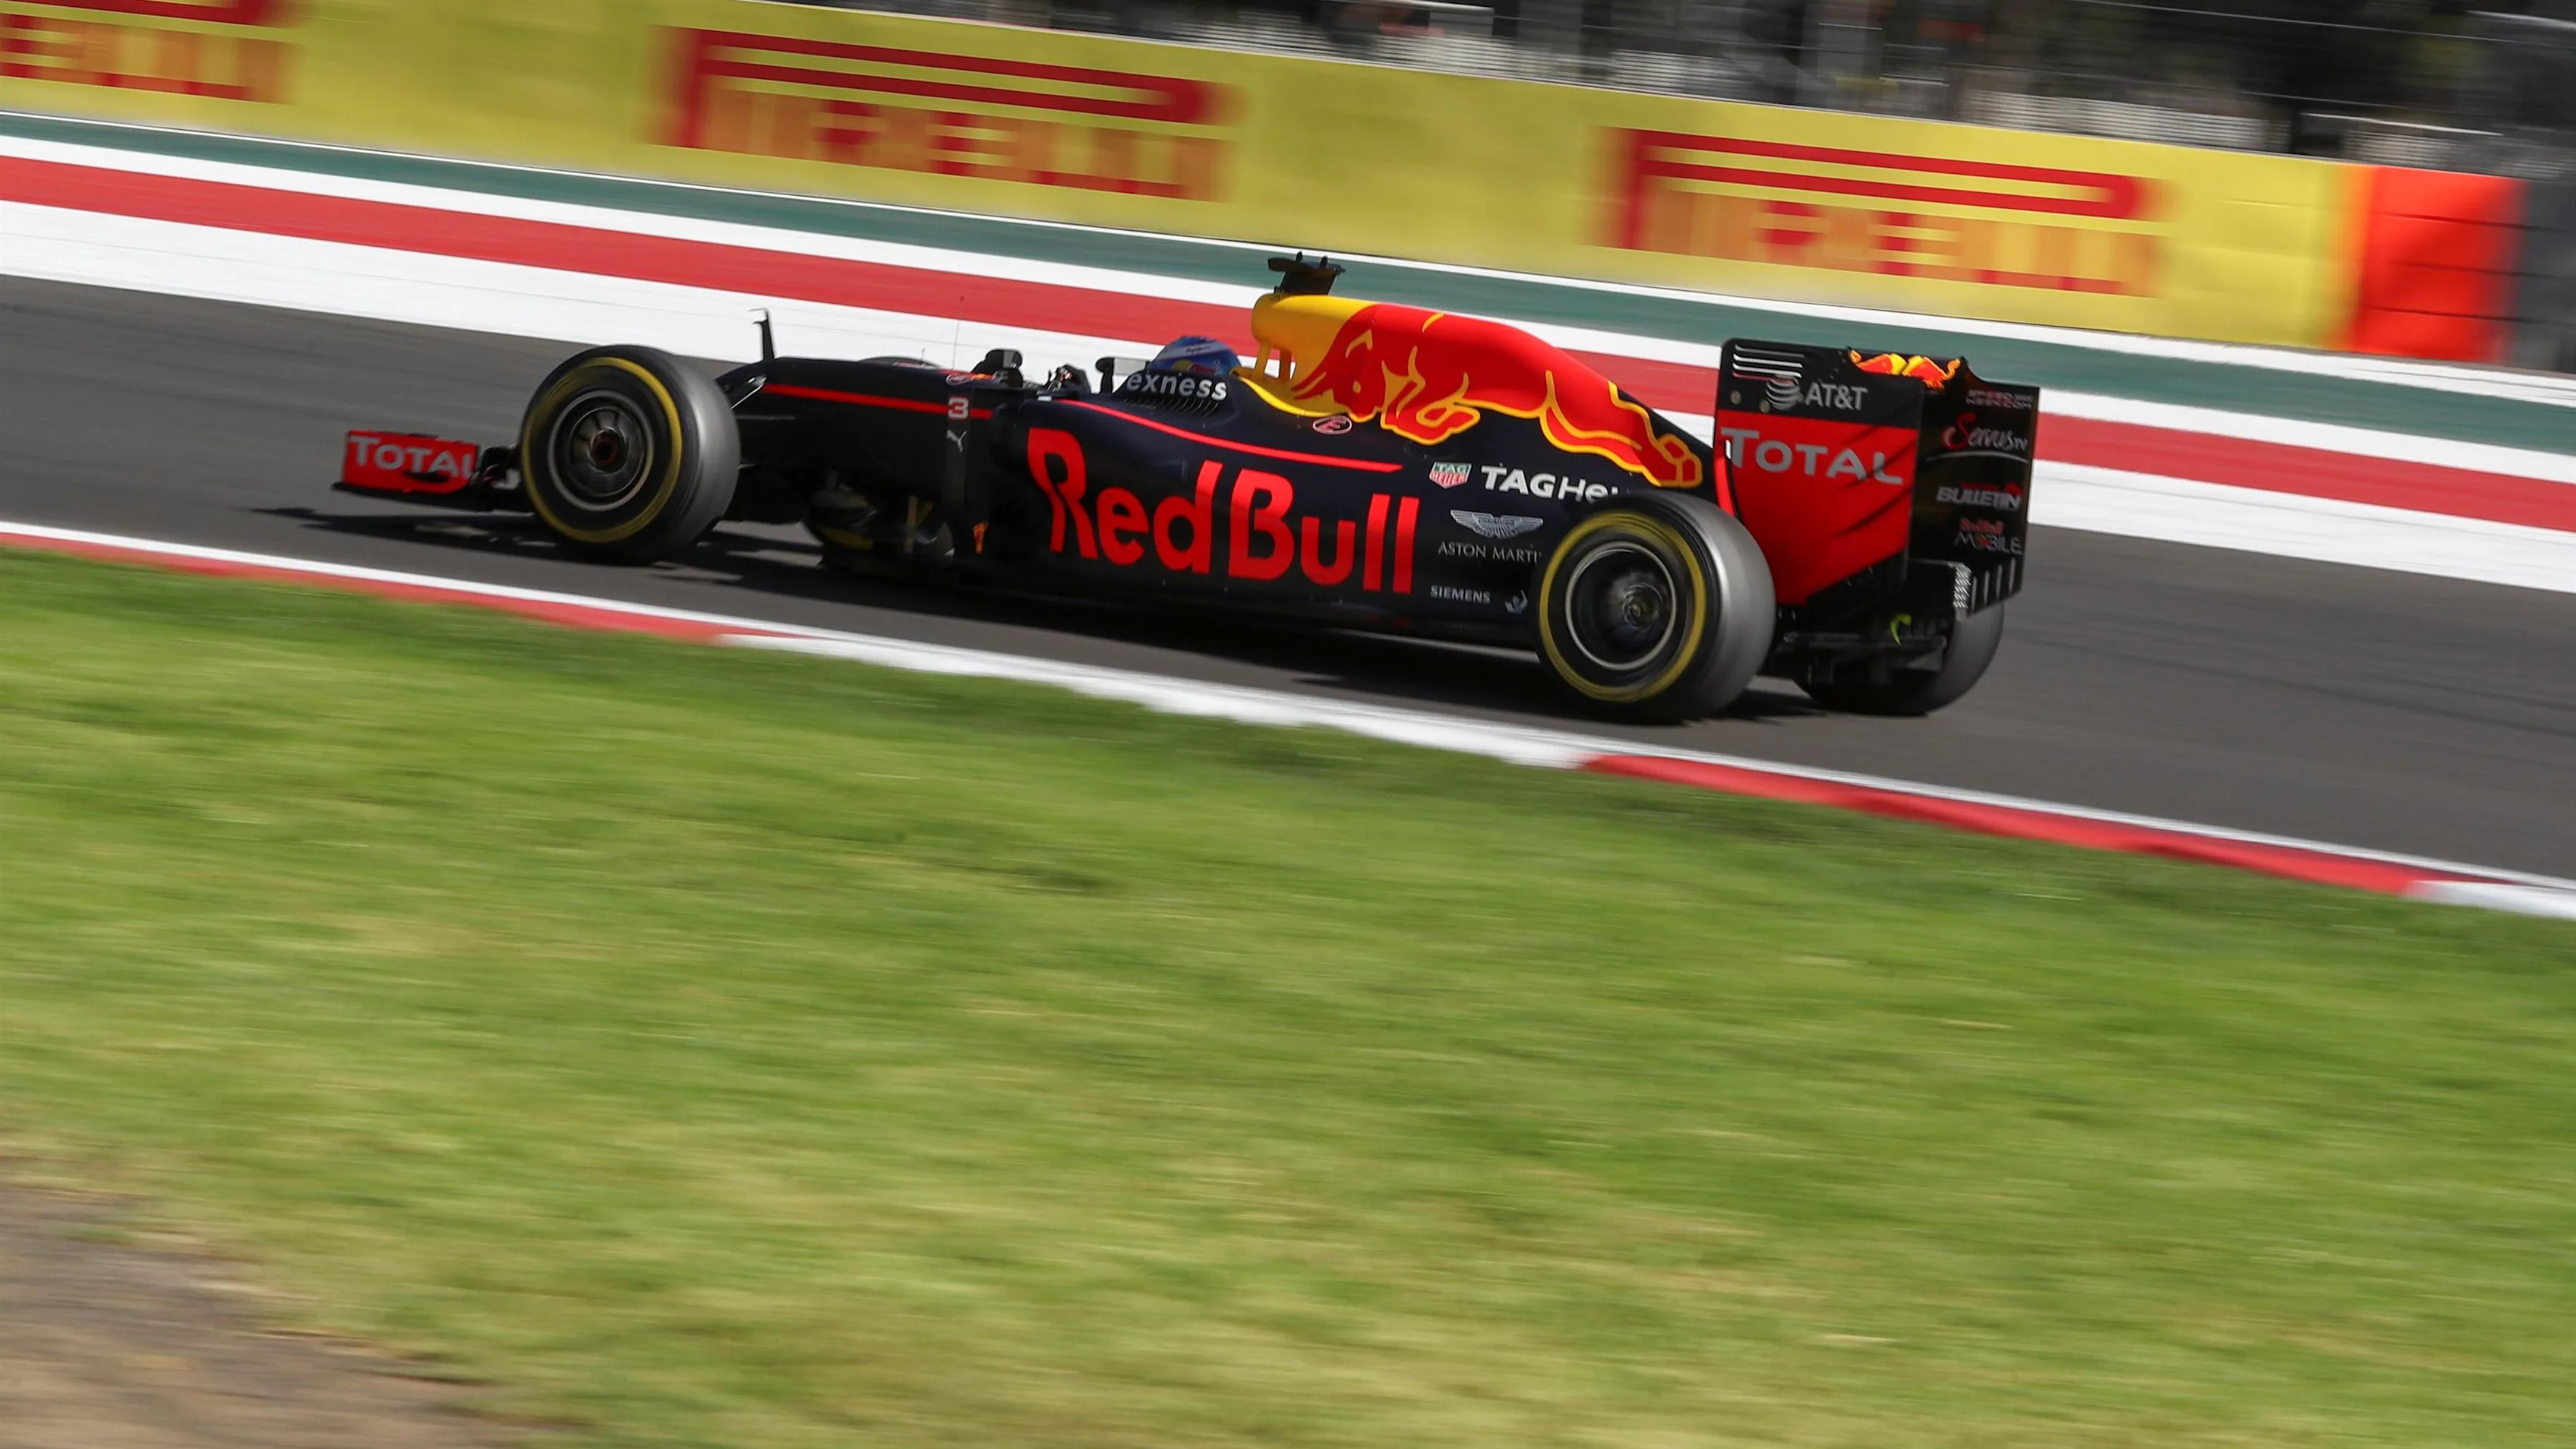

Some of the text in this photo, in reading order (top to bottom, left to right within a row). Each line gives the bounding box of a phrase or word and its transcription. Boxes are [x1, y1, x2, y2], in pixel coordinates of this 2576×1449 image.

[1127, 371, 1227, 401] exness
[1805, 381, 1868, 410] AT&T
[948, 397, 968, 419] 3
[1720, 427, 1903, 485] TOTAL
[1438, 541, 1542, 564] ASTON MARTI
[1430, 585, 1491, 604] SIEMENS
